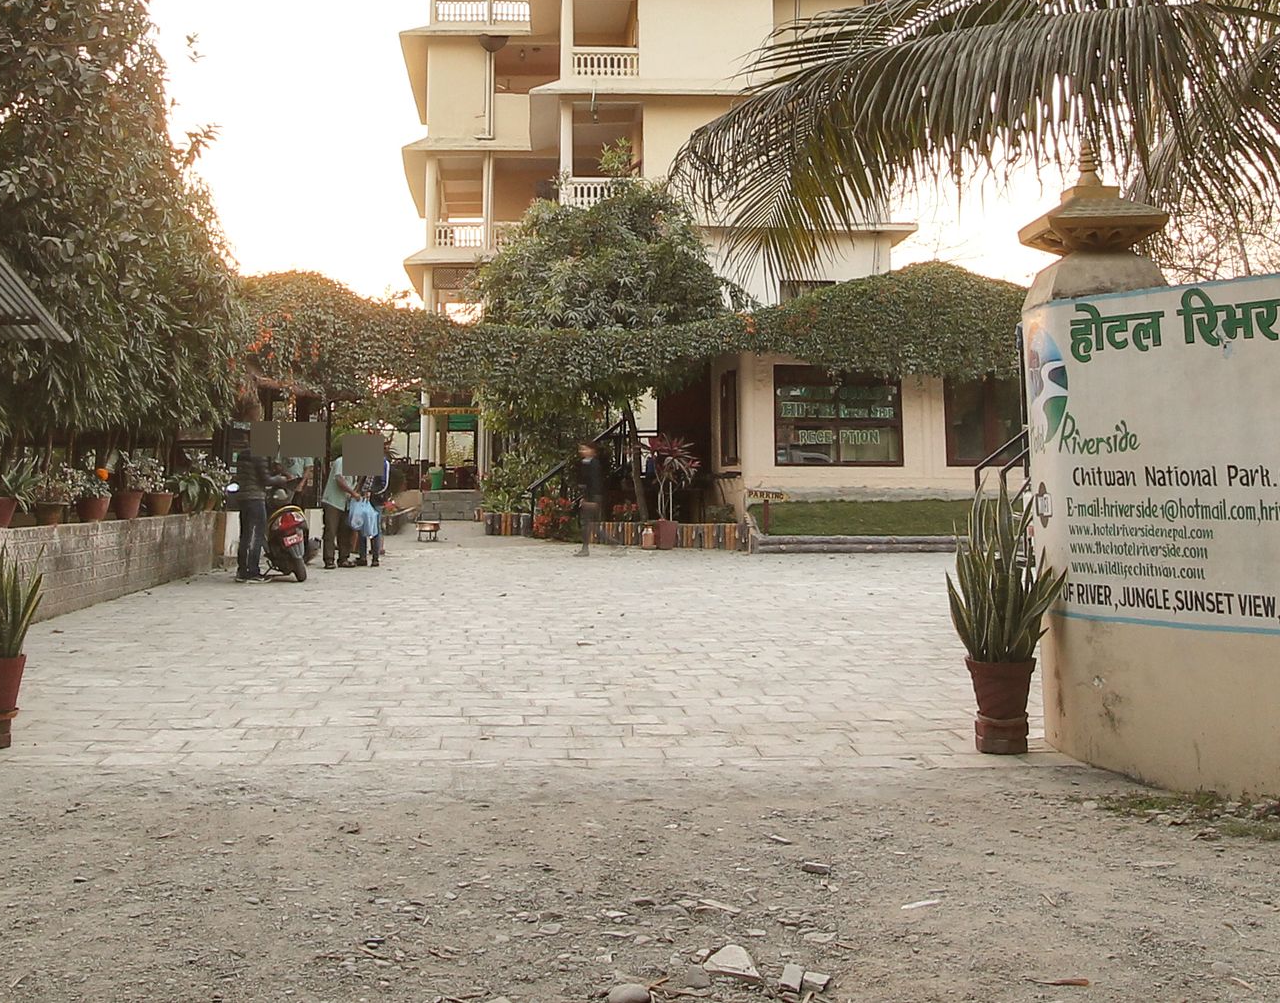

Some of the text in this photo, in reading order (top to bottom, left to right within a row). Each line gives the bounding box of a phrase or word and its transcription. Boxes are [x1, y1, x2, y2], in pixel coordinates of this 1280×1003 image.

[1070, 303, 1164, 363] होटल
[1058, 411, 1141, 455] Riverside
[1072, 466, 1137, 487] Chitwan
[1145, 465, 1218, 487] National
[748, 490, 784, 500] PARKING
[1069, 523, 1214, 542] www.hotelriversidenepal.com
[1070, 541, 1208, 560] www.thehotelriverside.com
[1071, 561, 1206, 580] www.wildlifechitwan.com
